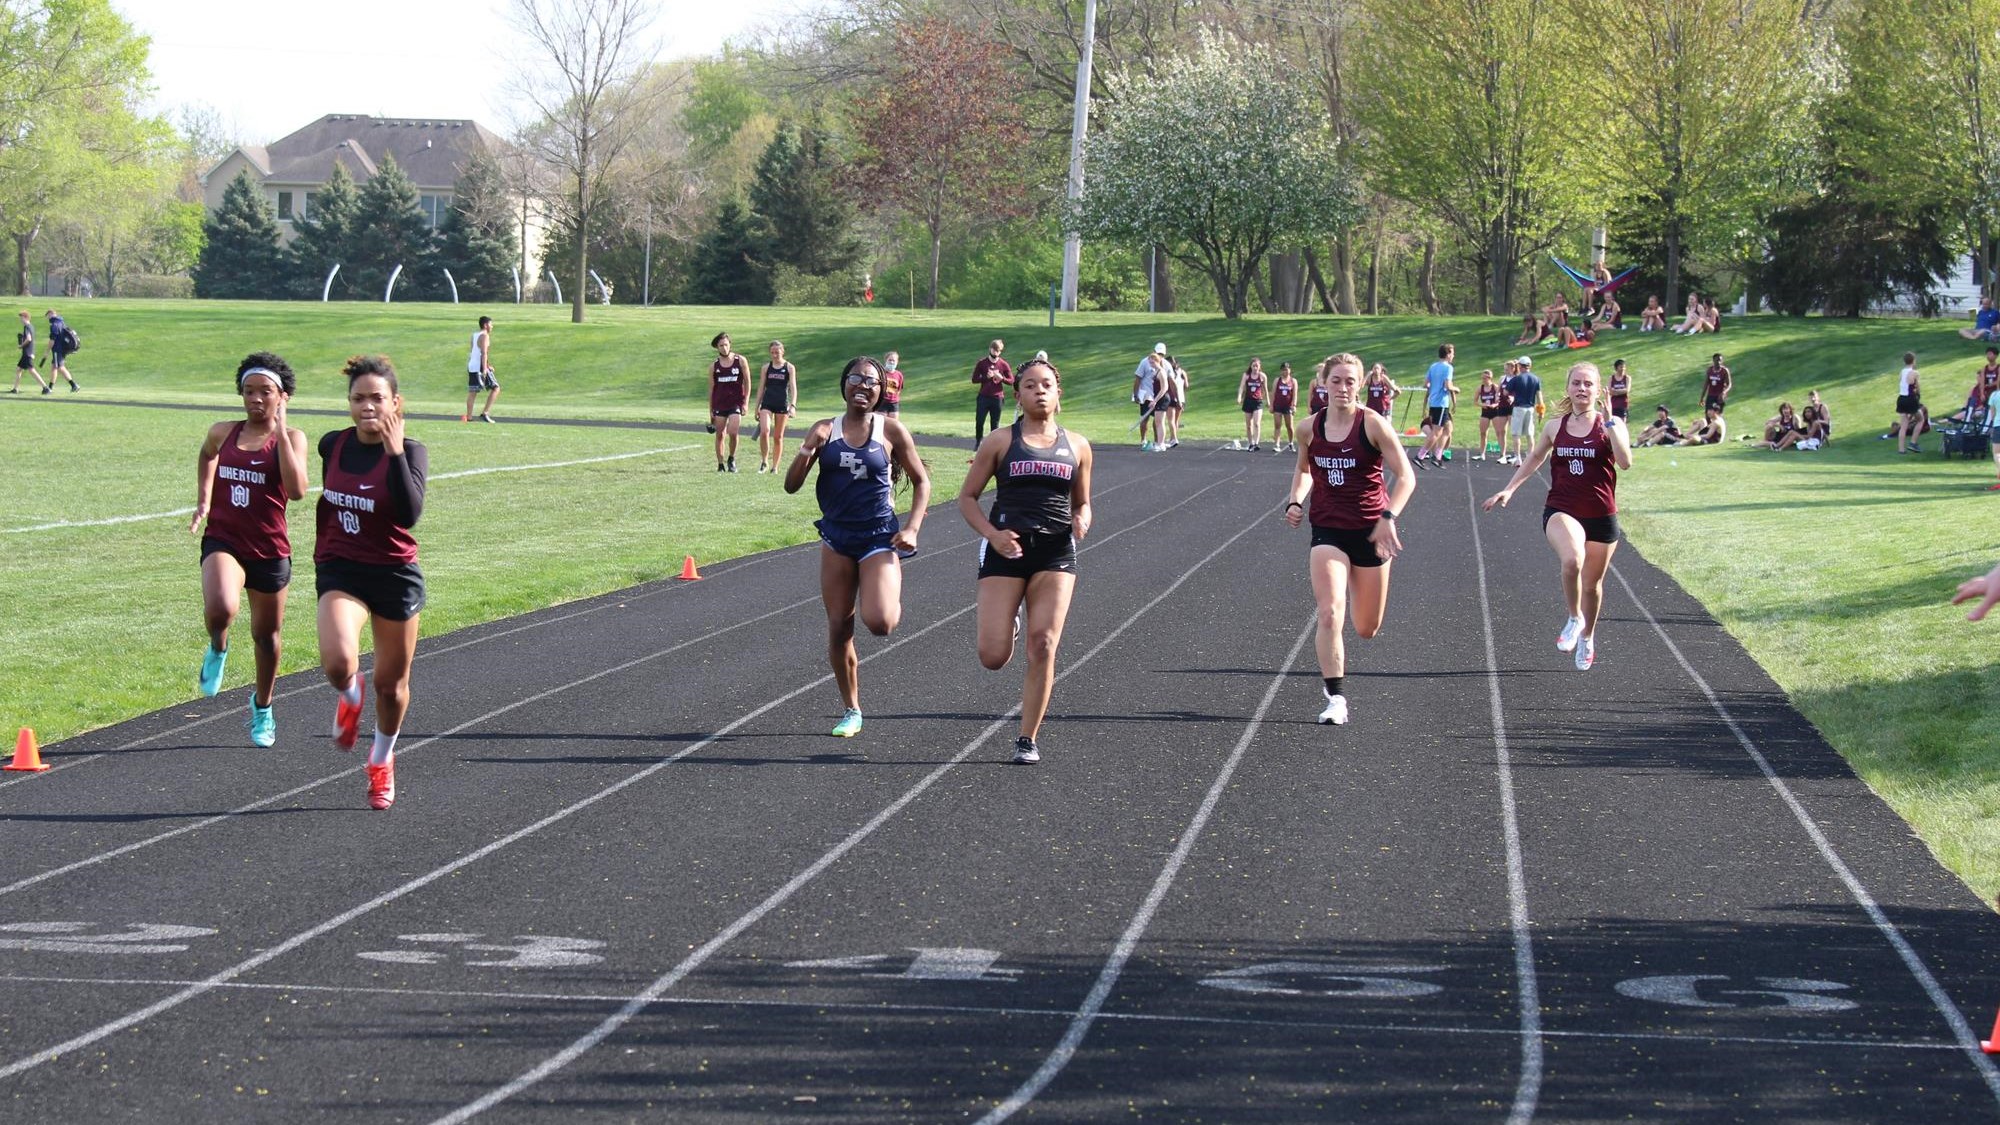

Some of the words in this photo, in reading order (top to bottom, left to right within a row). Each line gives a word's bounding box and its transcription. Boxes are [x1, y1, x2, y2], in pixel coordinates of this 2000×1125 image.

[1314, 456, 1356, 469] WHEATON
[1557, 447, 1595, 458] WHEATON
[219, 466, 266, 484] WHEATON
[1010, 460, 1073, 481] MONTINI
[323, 488, 375, 513] WHEATON
[0, 921, 217, 954] 2
[356, 933, 608, 968] 3
[783, 947, 1023, 982] 4
[1197, 962, 1453, 997] 5
[1615, 975, 1860, 1012] 6
